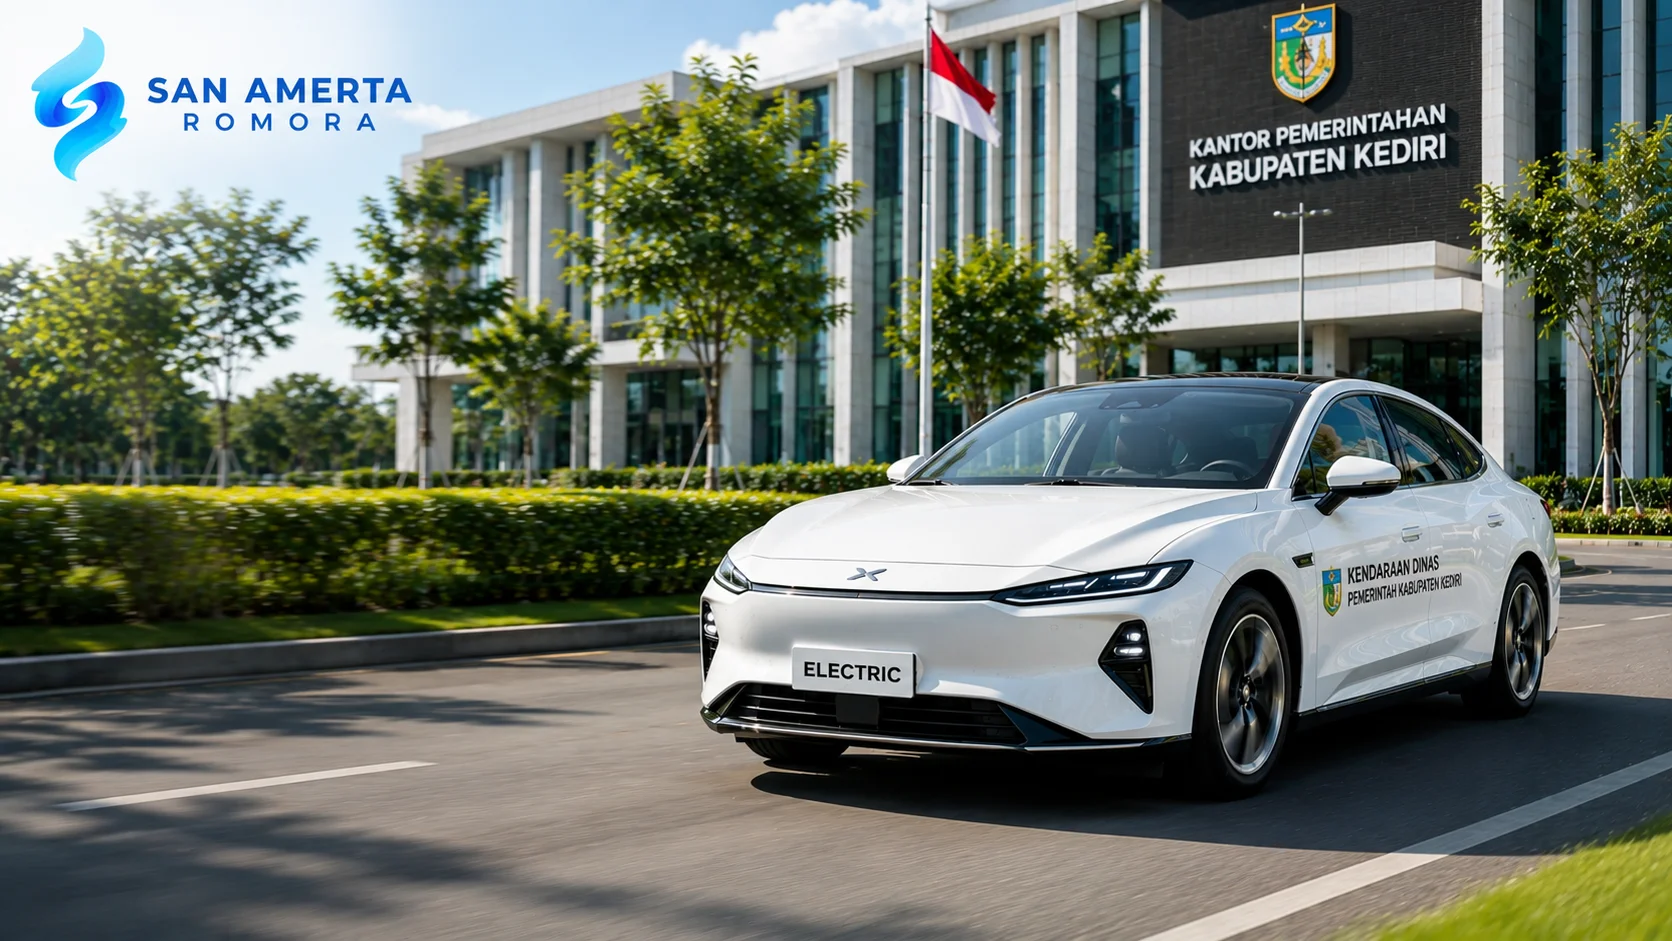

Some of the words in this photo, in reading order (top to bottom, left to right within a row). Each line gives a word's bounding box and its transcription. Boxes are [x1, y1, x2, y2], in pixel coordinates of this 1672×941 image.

[1189, 129, 1270, 158] KANTOR
[1276, 103, 1446, 146] PEMERINTAHAN
[1189, 146, 1346, 190] KABUPATEN
[1354, 133, 1446, 169] KEDIRI
[1347, 559, 1410, 584] KENDARAAN
[1412, 554, 1440, 574] DINAS
[1347, 586, 1397, 607] PEMERINTAH
[1398, 577, 1440, 597] KABUPATEN
[1440, 572, 1463, 590] KEDIRI
[803, 661, 902, 683] ELECTRIC
